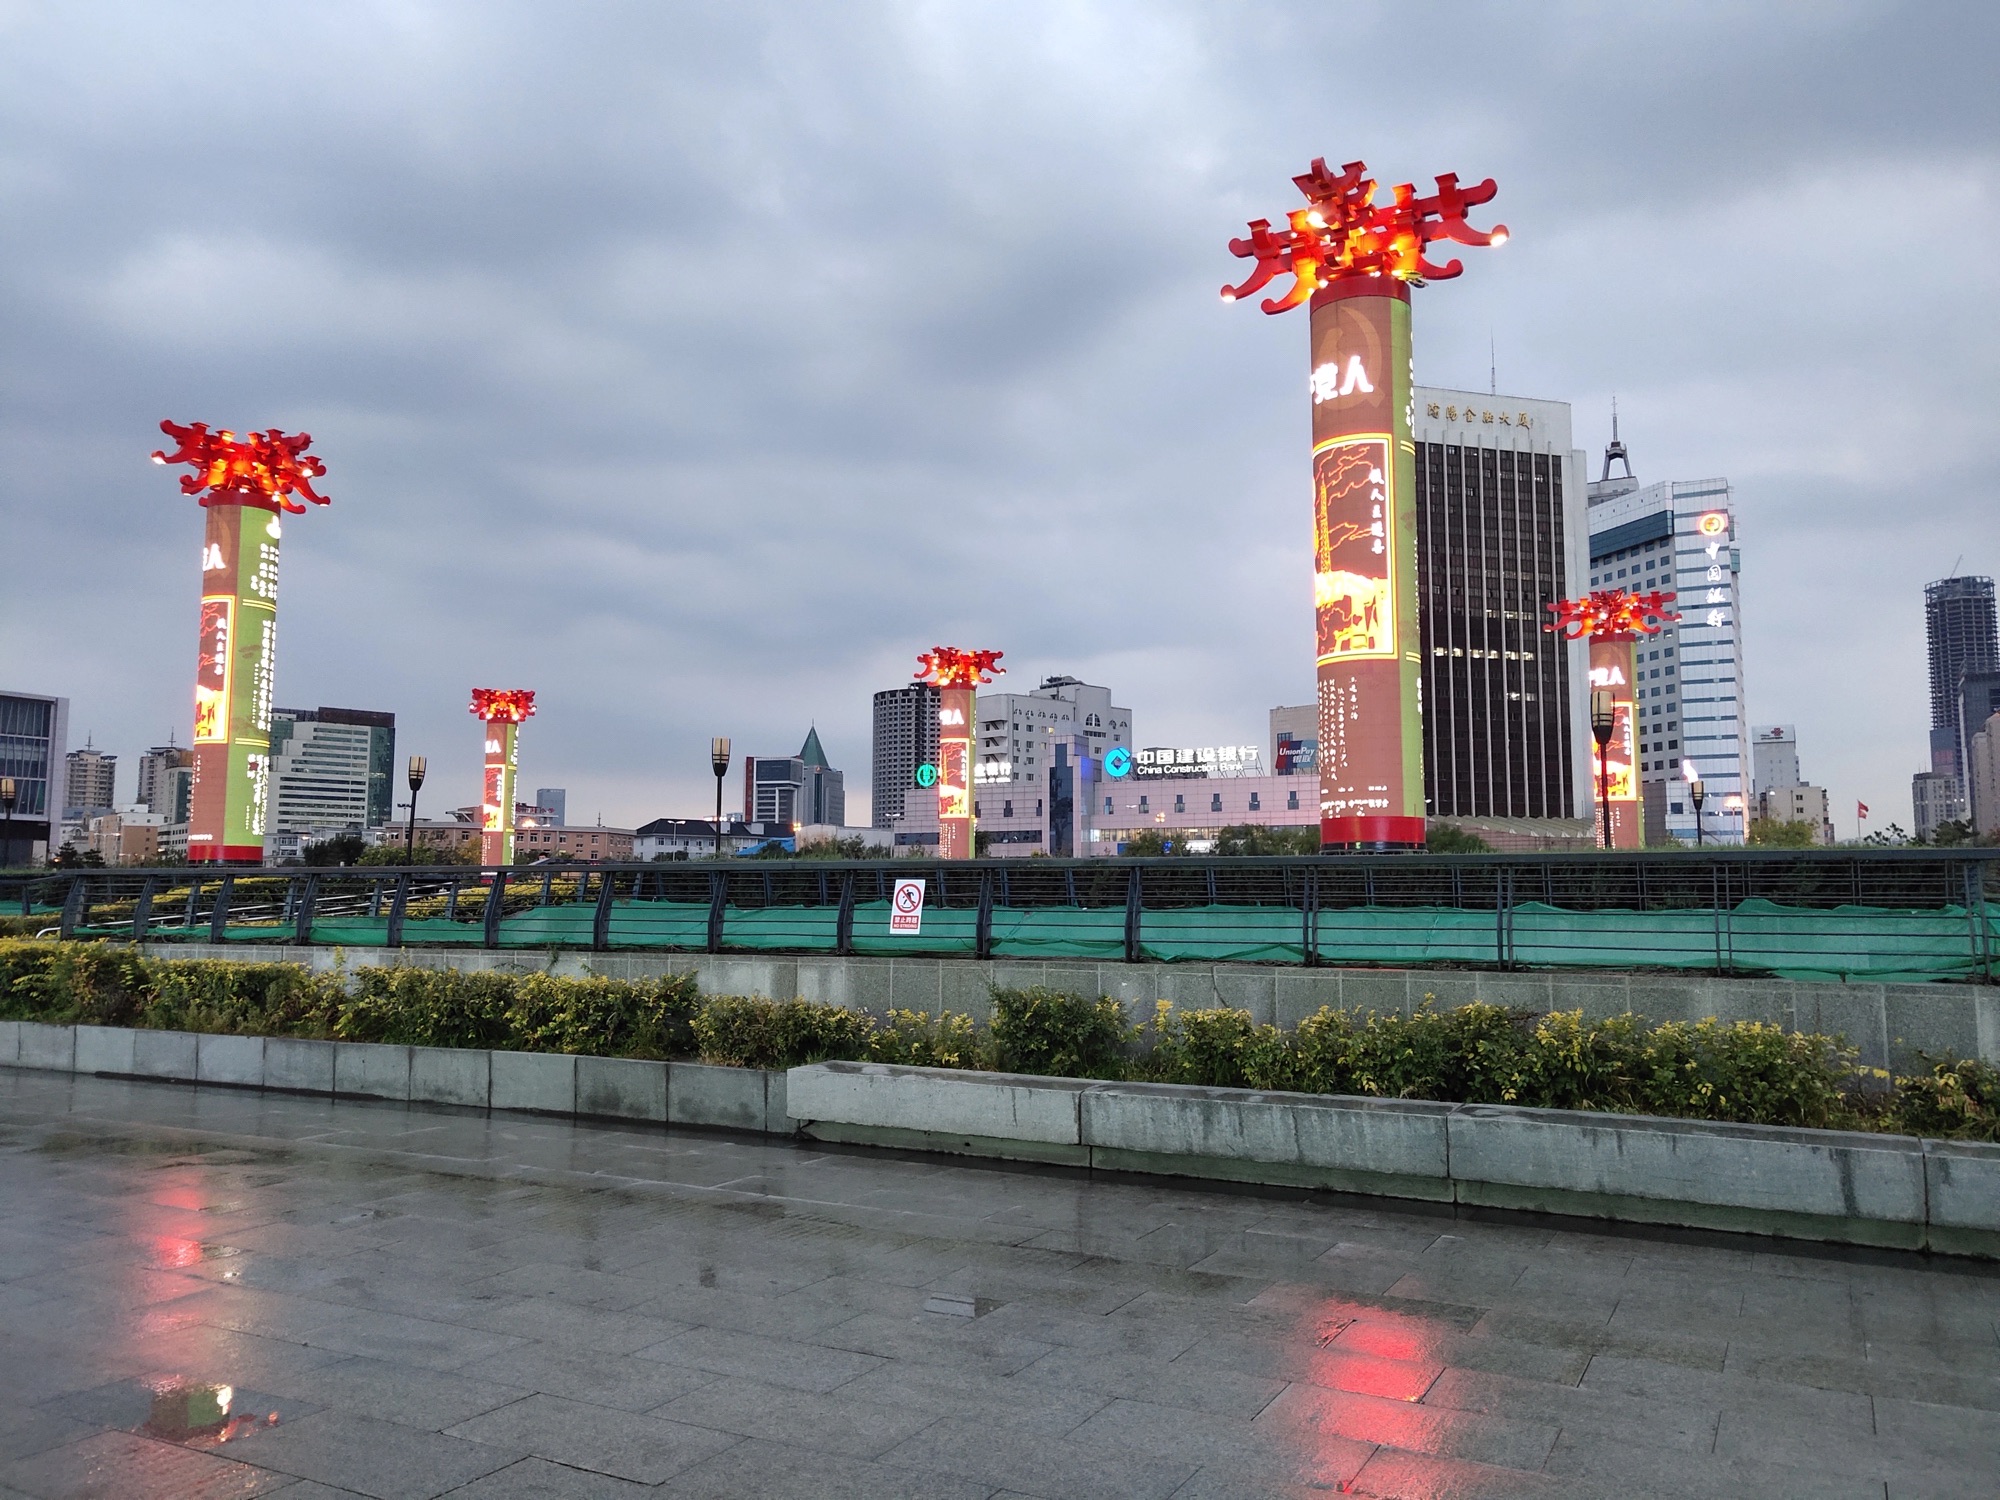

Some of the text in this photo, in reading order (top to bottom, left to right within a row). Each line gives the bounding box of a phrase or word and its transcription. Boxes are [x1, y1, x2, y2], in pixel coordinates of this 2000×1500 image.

[1705, 541, 1726, 628] 中国银行
[1136, 745, 1259, 765] 中国建设银行
[1279, 746, 1316, 758] UnionPay
[1137, 762, 1244, 775] China Construction Bank
